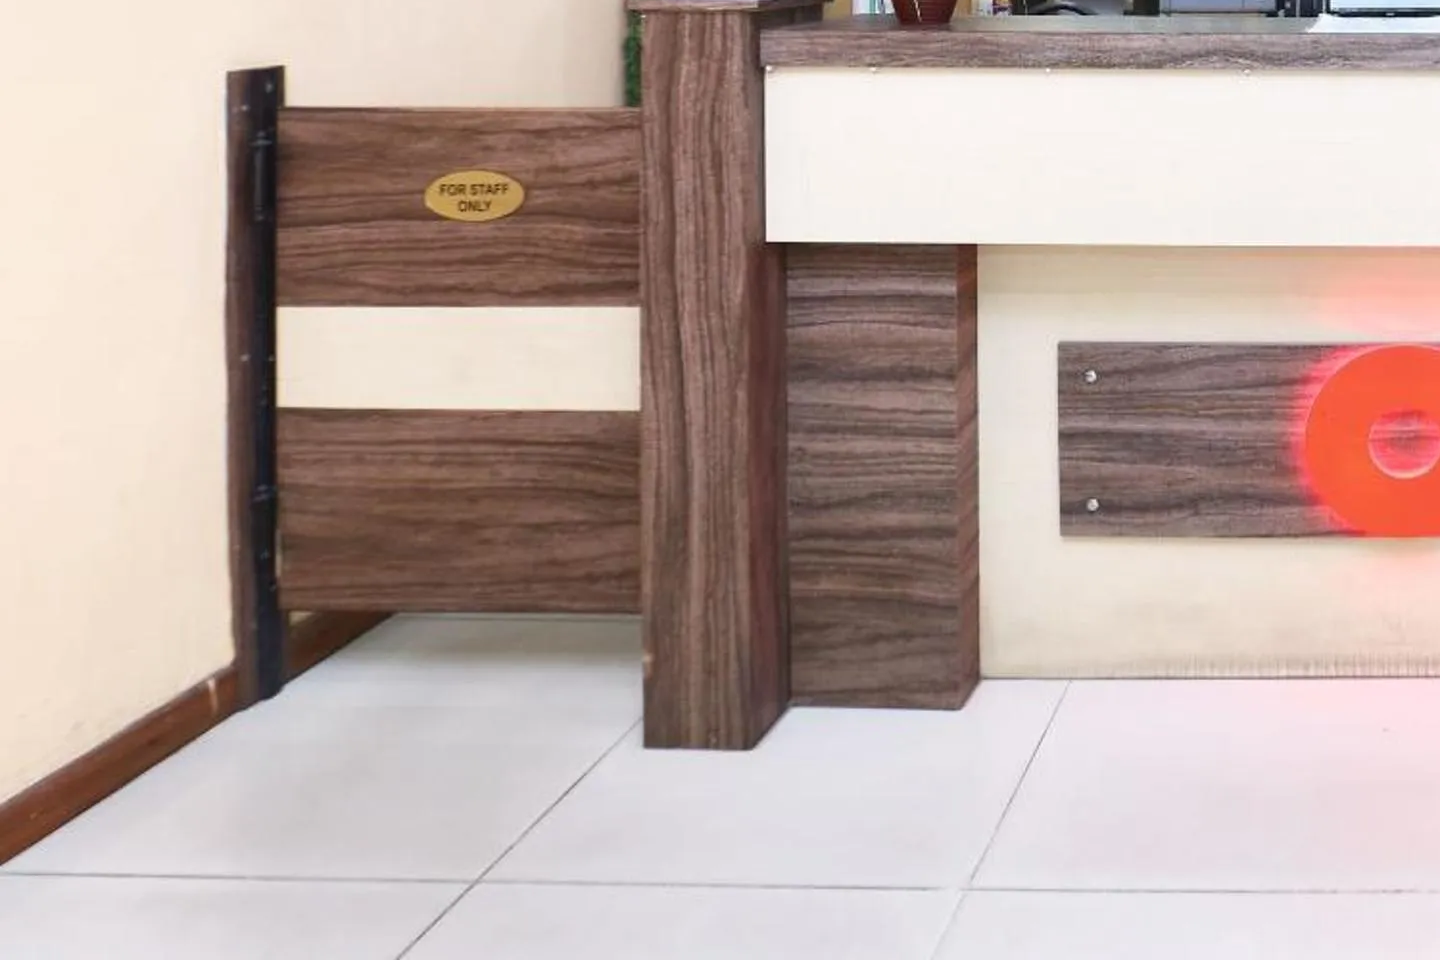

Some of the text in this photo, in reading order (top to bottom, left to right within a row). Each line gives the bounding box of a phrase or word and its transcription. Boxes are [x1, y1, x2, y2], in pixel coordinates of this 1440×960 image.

[439, 183, 508, 196] FOR STAFF
[458, 200, 492, 212] ONLY
